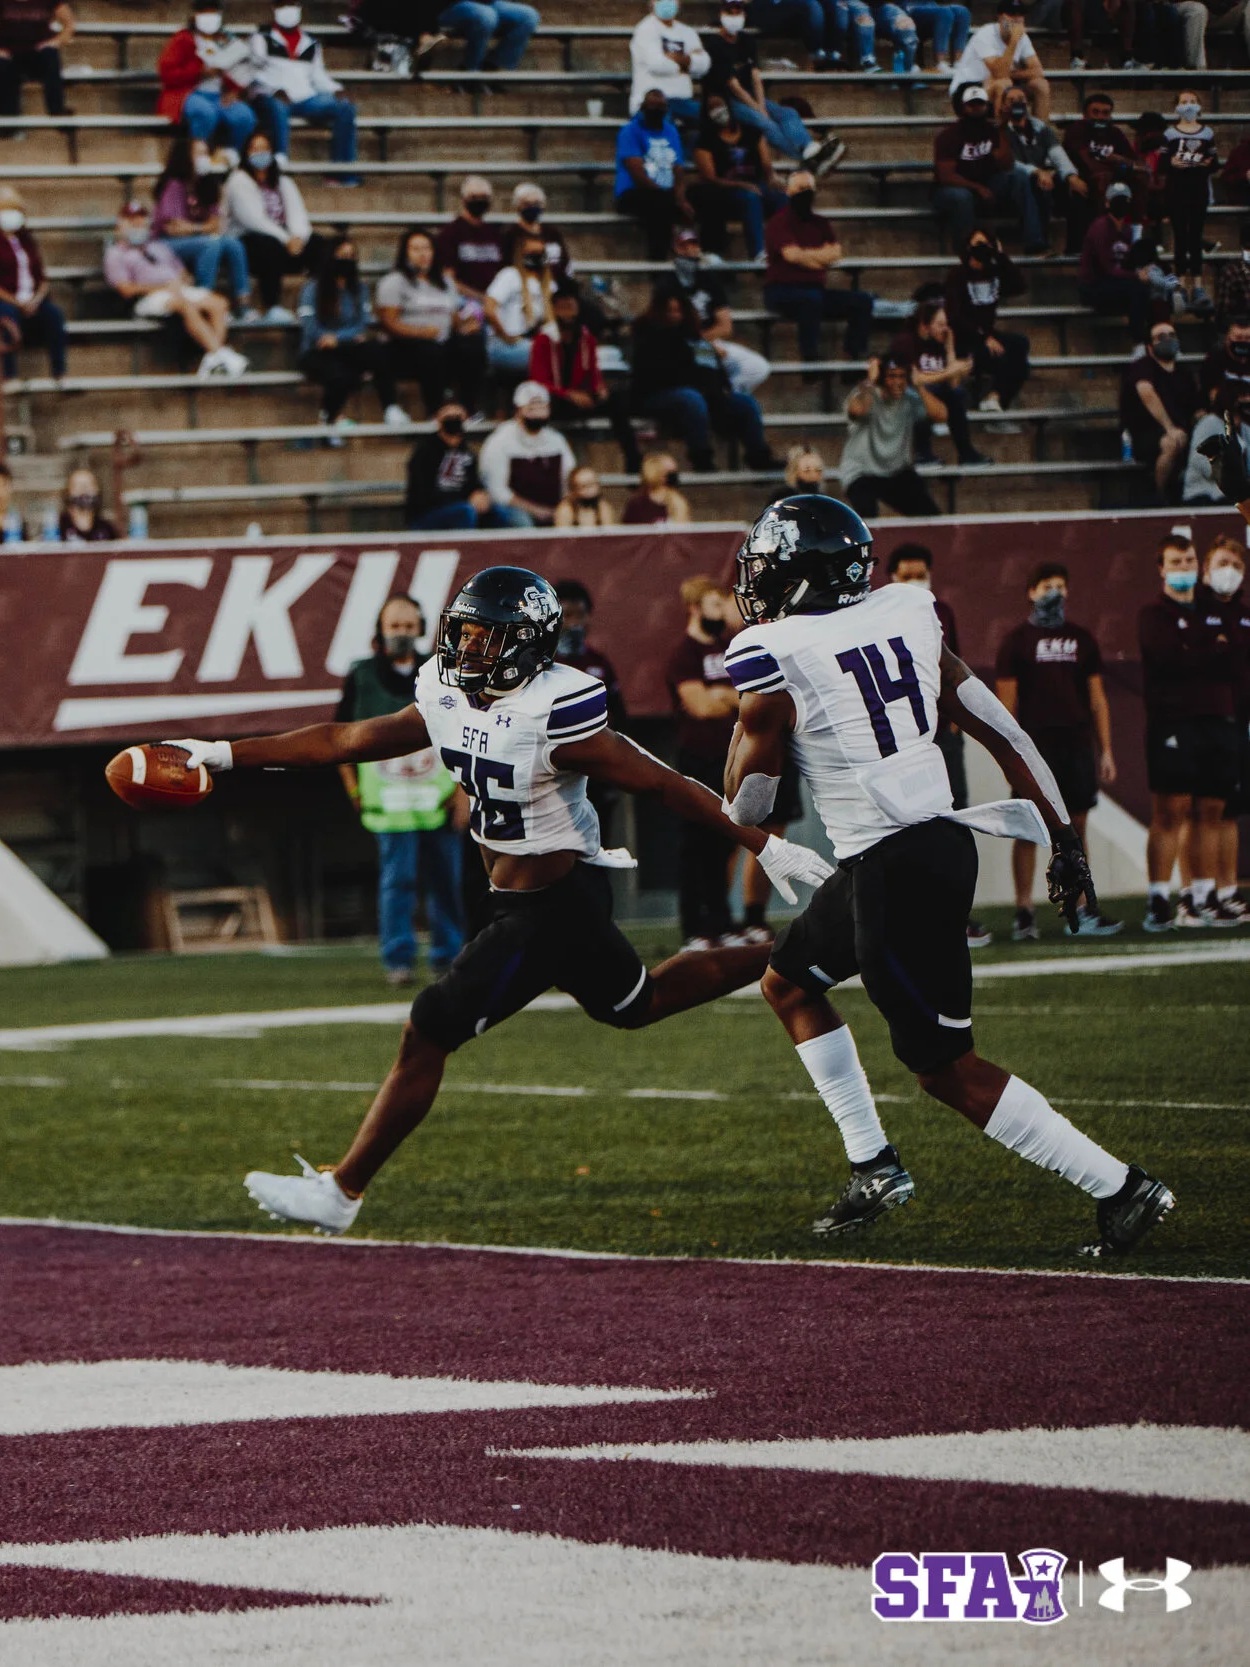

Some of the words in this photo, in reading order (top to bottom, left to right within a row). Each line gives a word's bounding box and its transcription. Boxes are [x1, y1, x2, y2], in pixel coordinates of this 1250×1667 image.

[67, 549, 461, 686] EKU
[461, 726, 489, 754] SFA
[834, 636, 930, 759] 14
